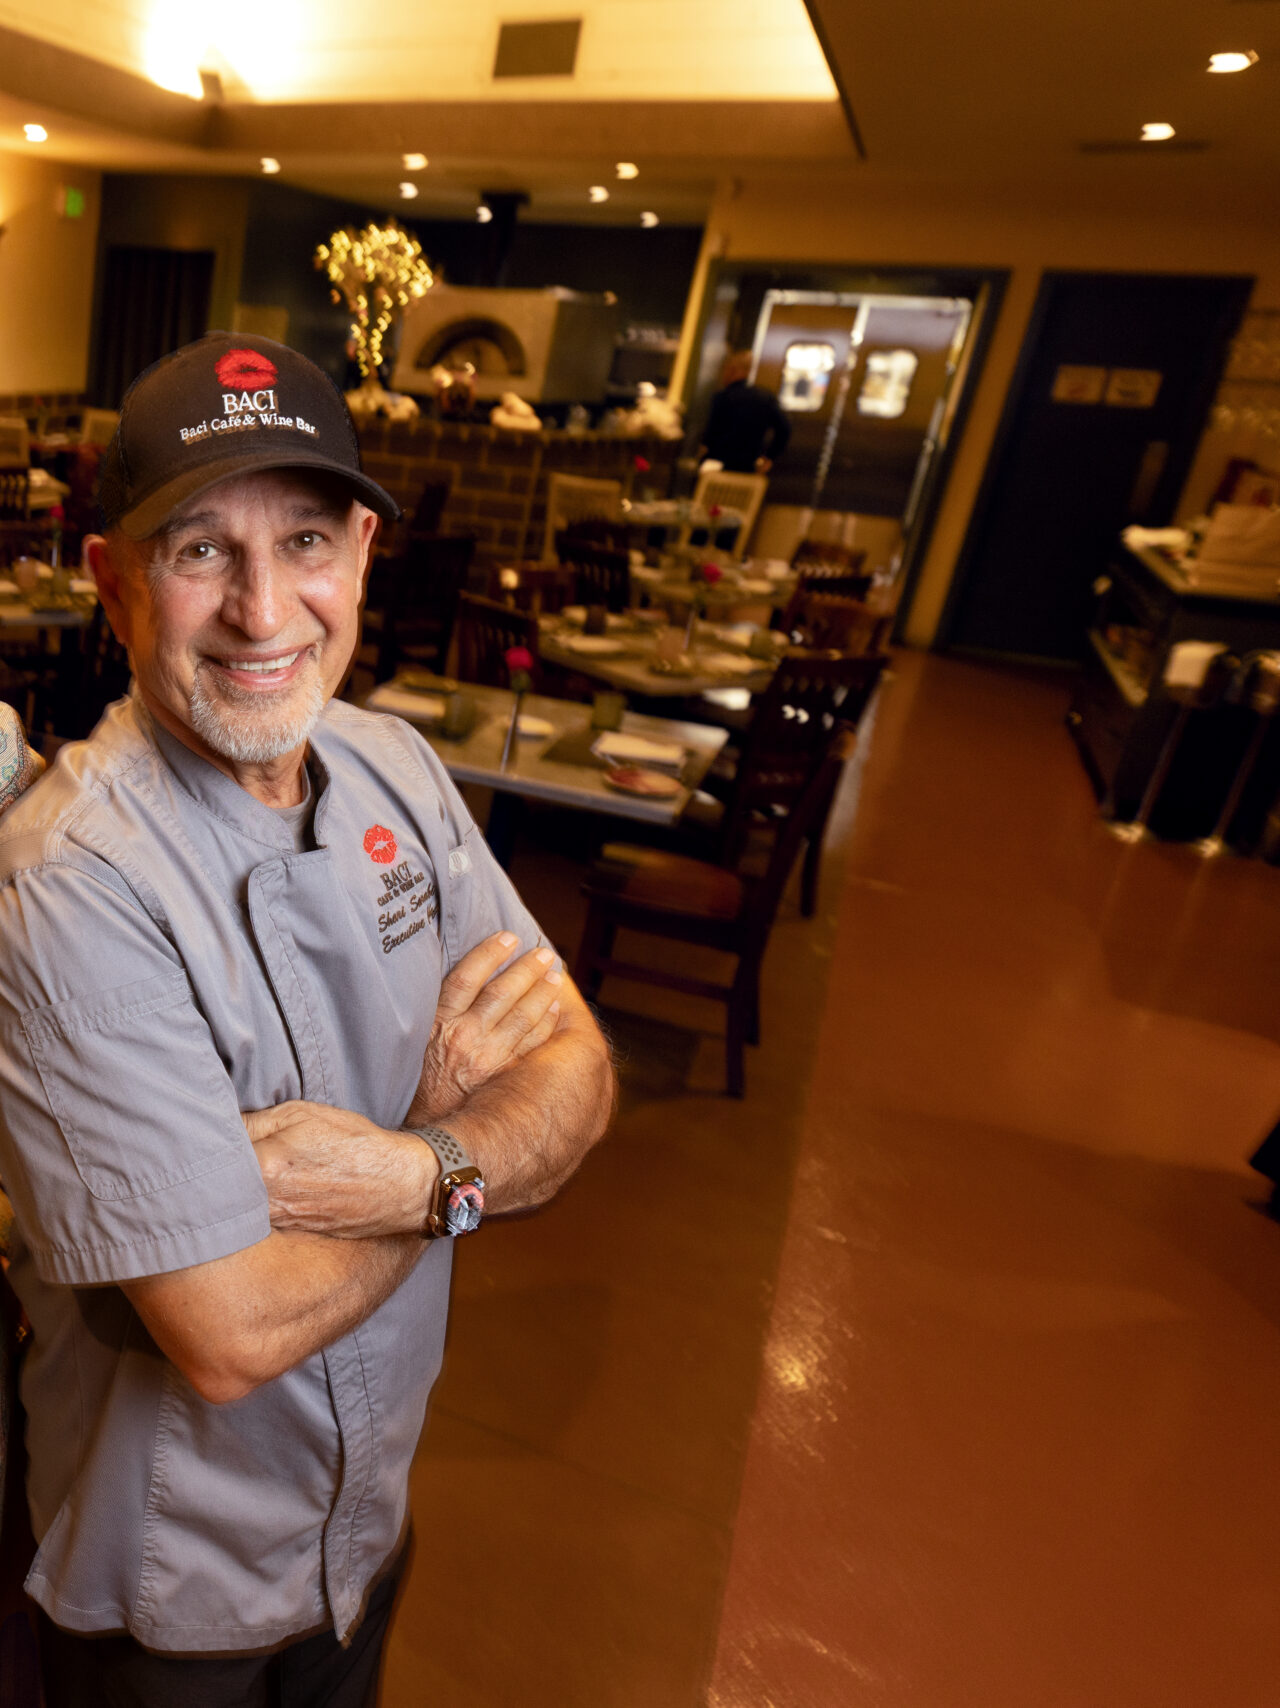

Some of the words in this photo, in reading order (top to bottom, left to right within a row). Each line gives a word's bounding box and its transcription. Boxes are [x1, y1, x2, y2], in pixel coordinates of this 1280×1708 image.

[222, 390, 276, 414] BACI
[179, 420, 207, 440] Baci
[211, 414, 241, 431] Café
[242, 414, 256, 426] &
[259, 413, 293, 427] Wine
[296, 416, 316, 434] Bar
[380, 861, 412, 891] BACI
[382, 918, 426, 954] Executive
